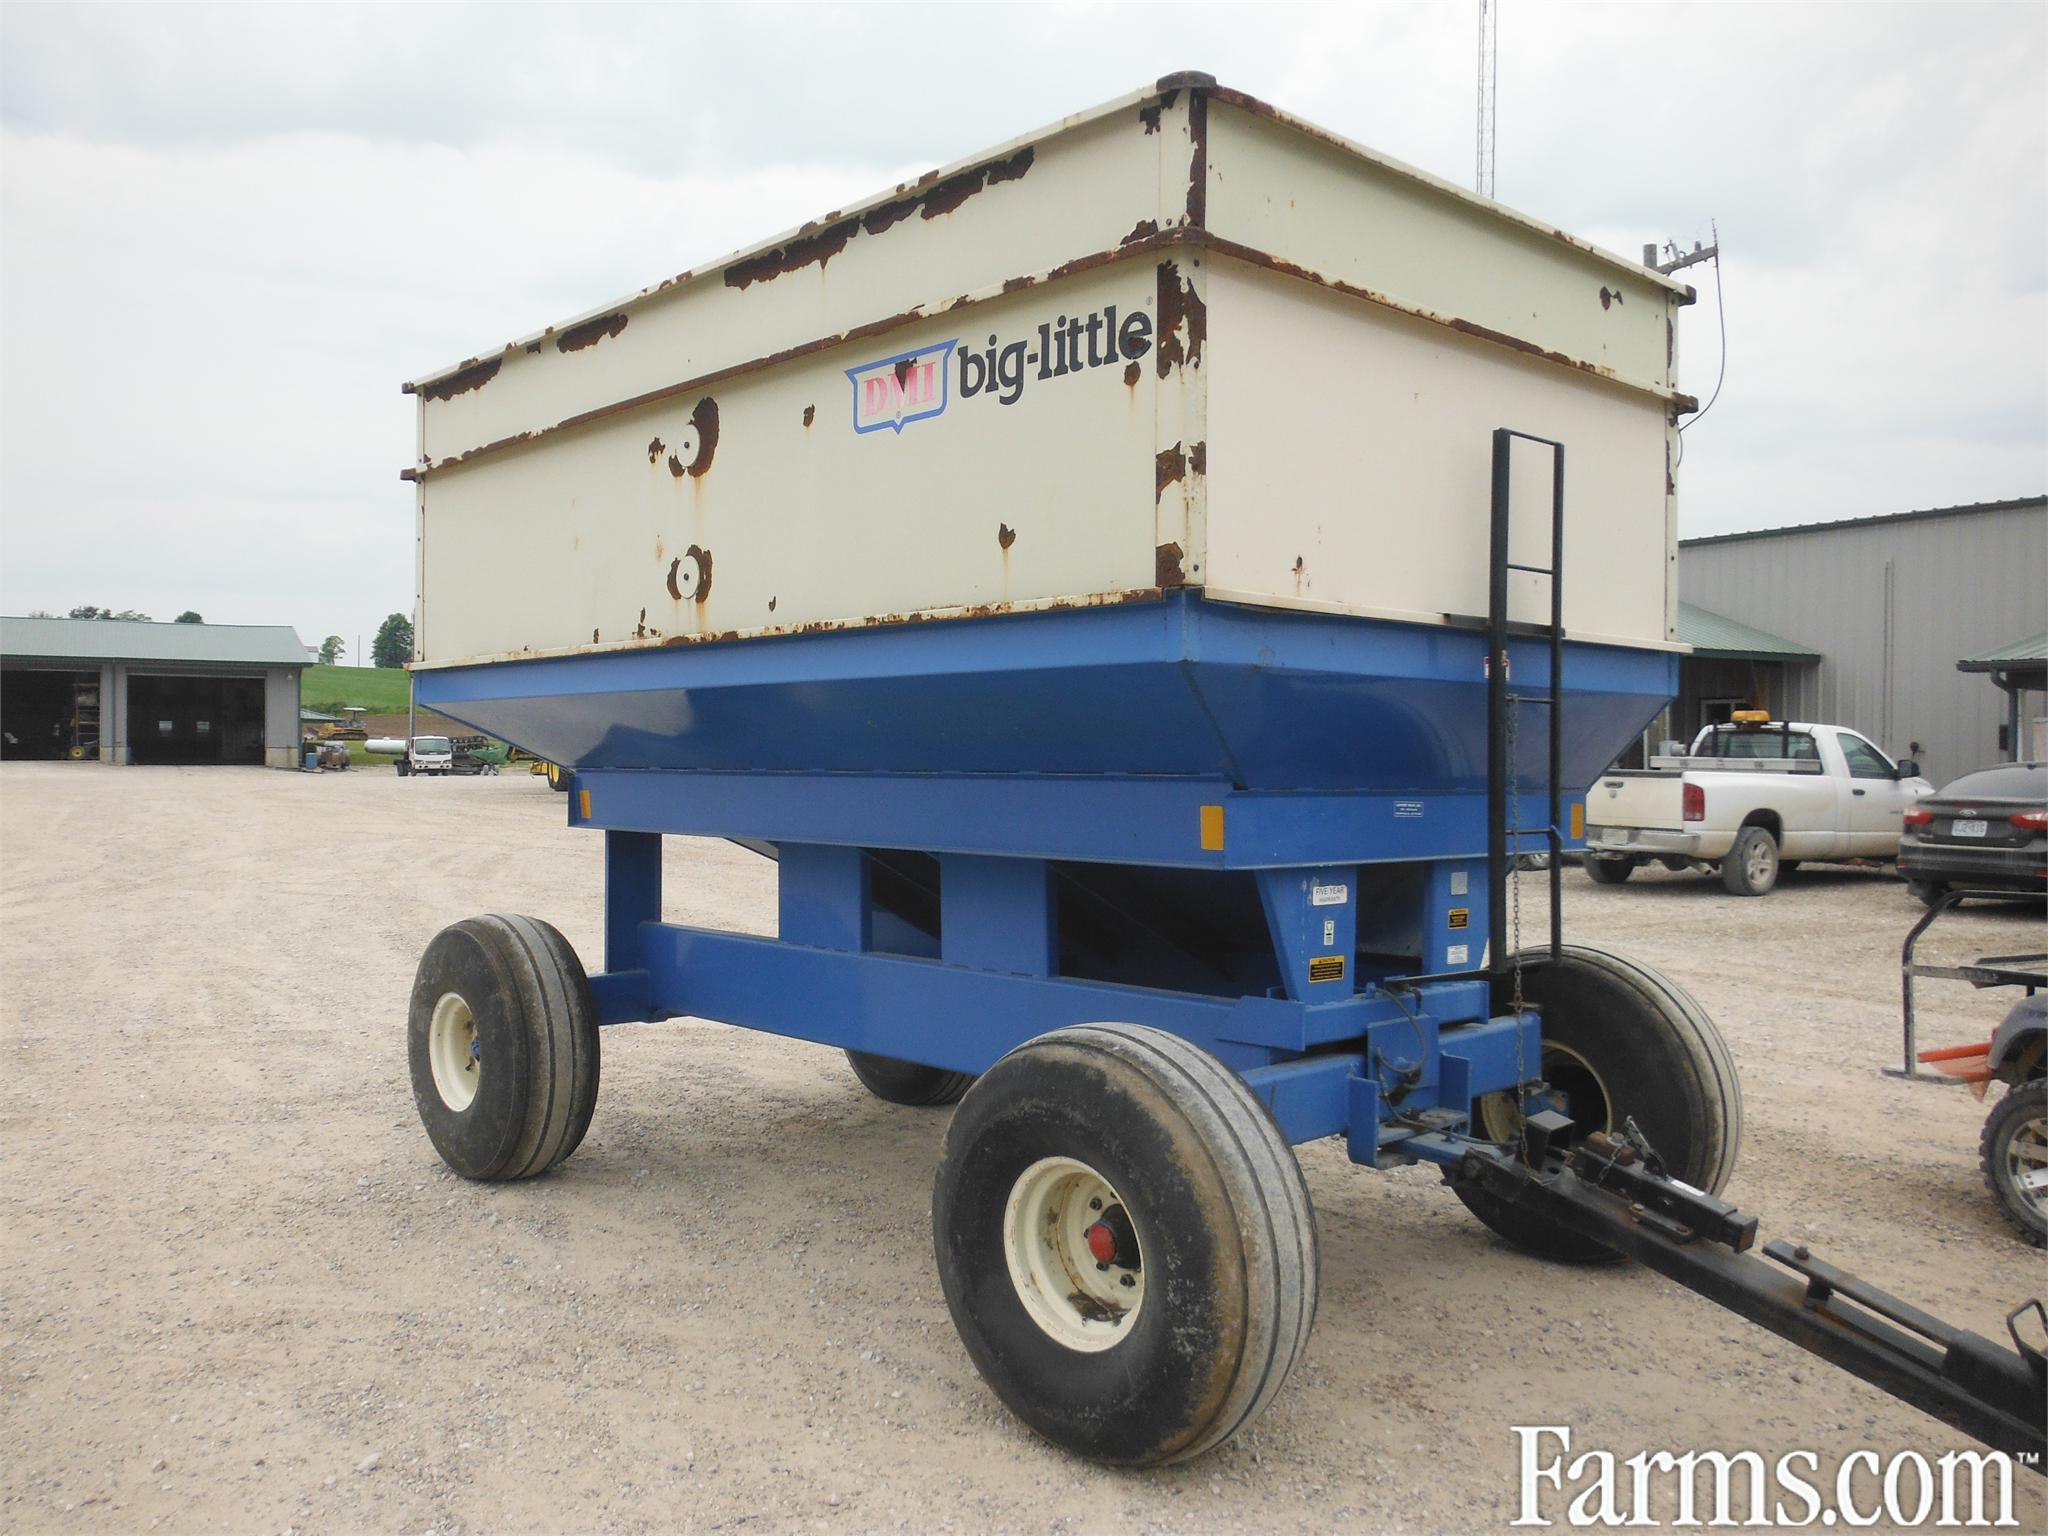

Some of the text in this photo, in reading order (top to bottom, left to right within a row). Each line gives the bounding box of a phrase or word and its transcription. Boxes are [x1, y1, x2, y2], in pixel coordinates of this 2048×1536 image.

[863, 305, 1153, 417] DMI big-little
[1315, 886, 1345, 896] FIVE YEAR
